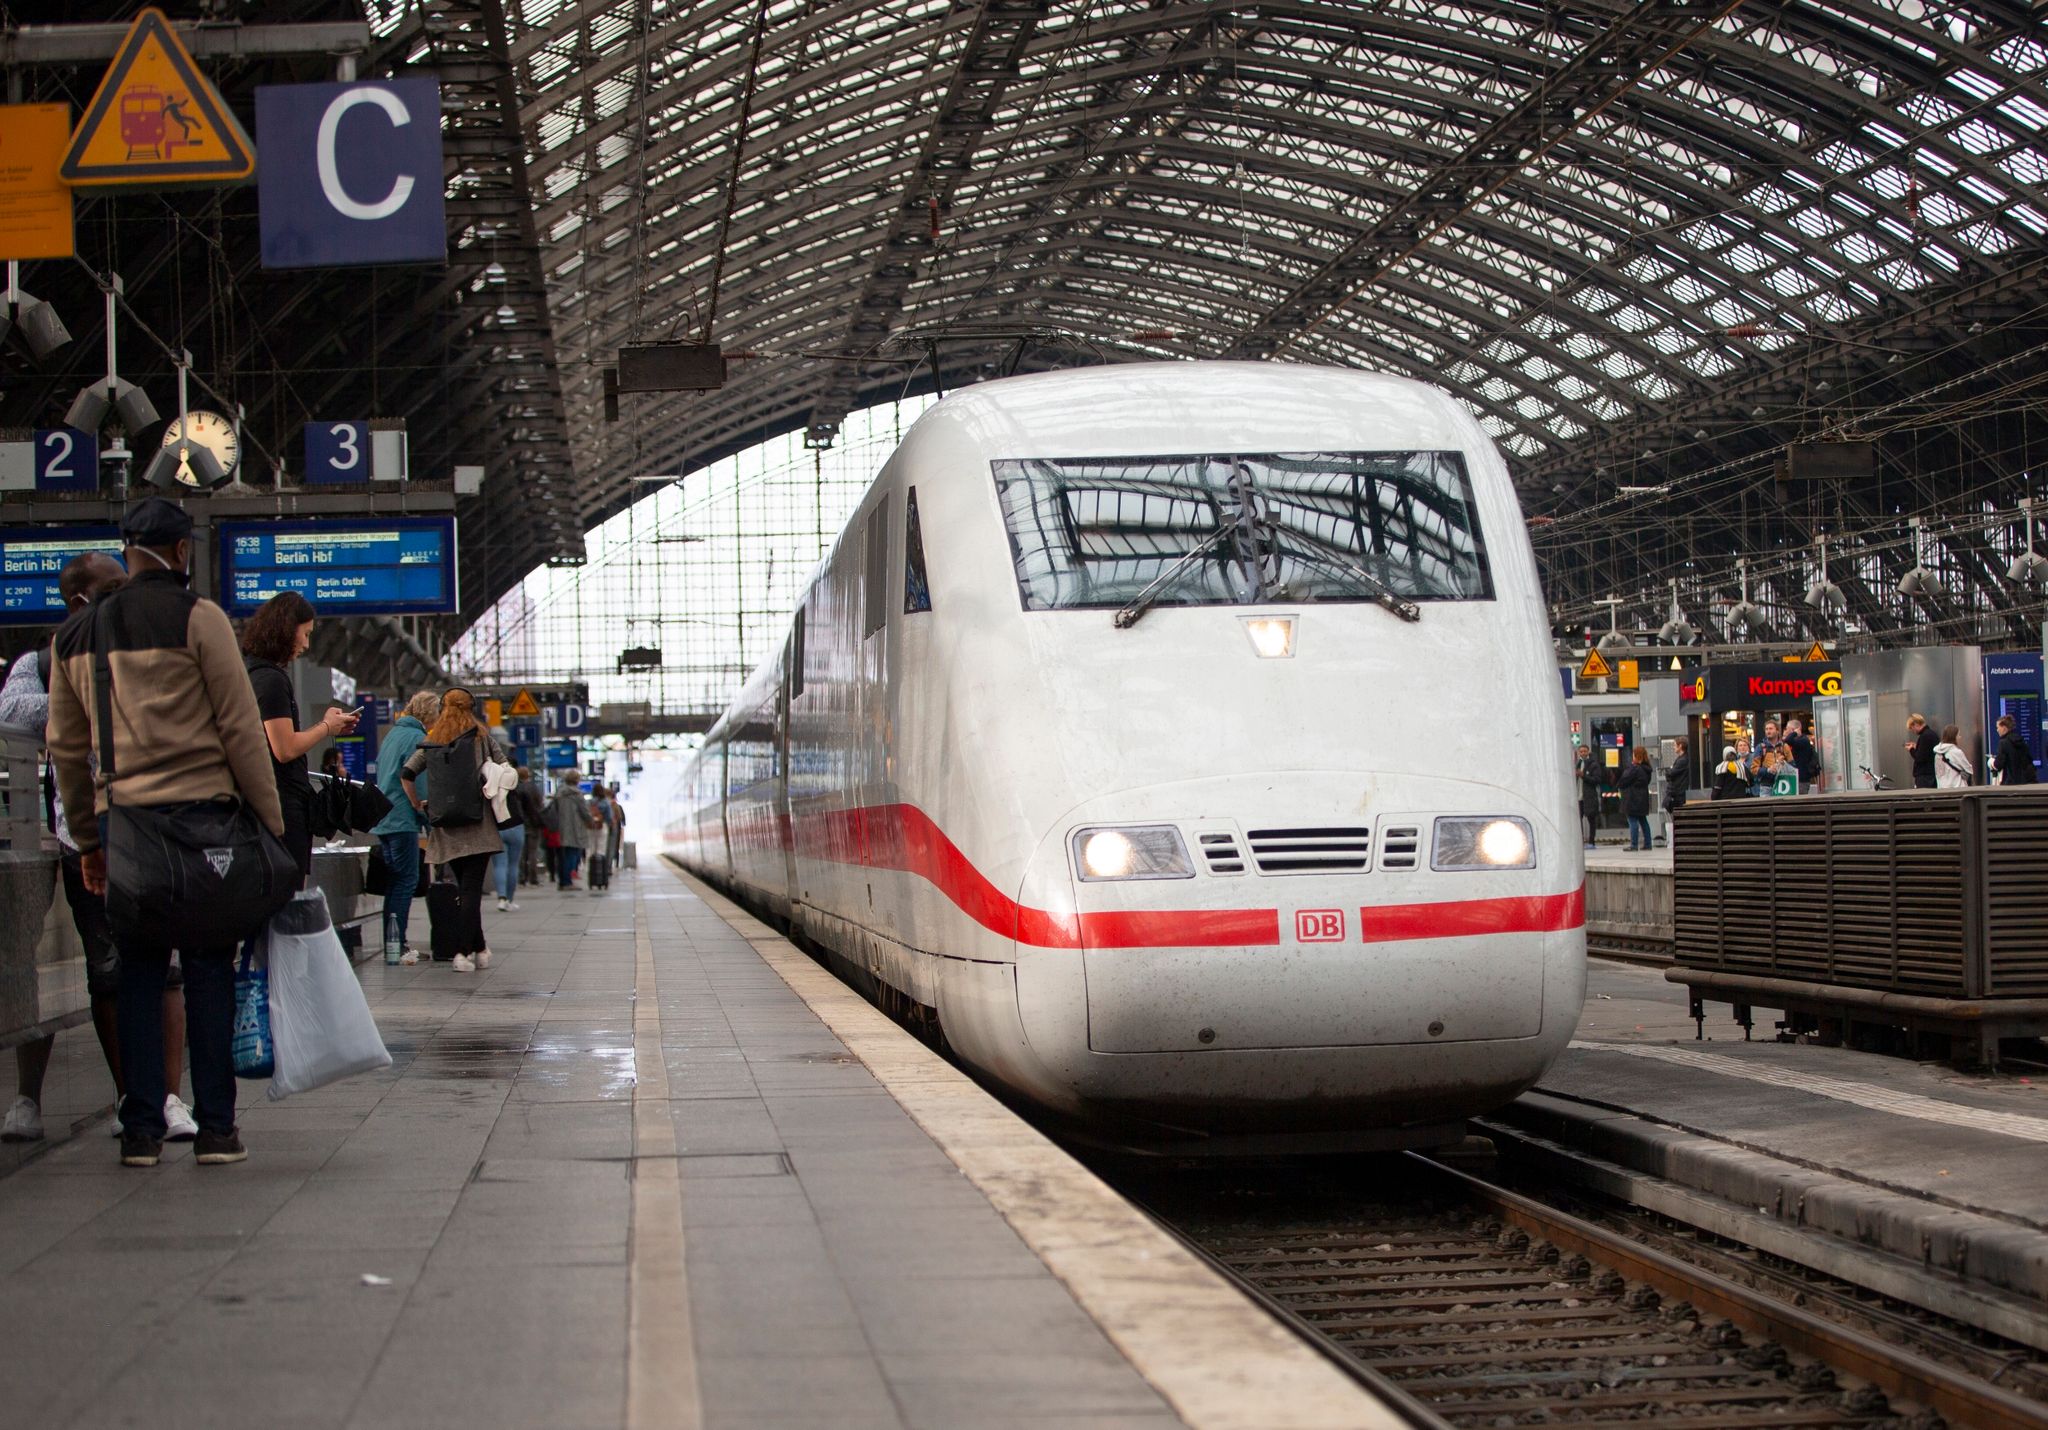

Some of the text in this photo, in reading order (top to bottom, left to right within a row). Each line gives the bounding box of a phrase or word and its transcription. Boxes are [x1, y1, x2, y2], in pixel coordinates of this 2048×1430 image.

[317, 86, 415, 220] C
[328, 423, 360, 470] 3
[44, 431, 74, 478] 2
[275, 550, 333, 564] Berlin Hbf
[4, 558, 62, 572] Berlin Hbf
[316, 578, 340, 586] Berlin
[342, 577, 367, 586] Ostbf.
[316, 589, 356, 598] Dortmund
[16, 598, 23, 606] 7
[1990, 667, 2012, 675] Abfahrt
[1748, 676, 1816, 698] Kamps
[565, 704, 584, 728] D
[593, 760, 604, 774] E
[1777, 779, 1791, 795] D
[1301, 914, 1339, 937] DB
